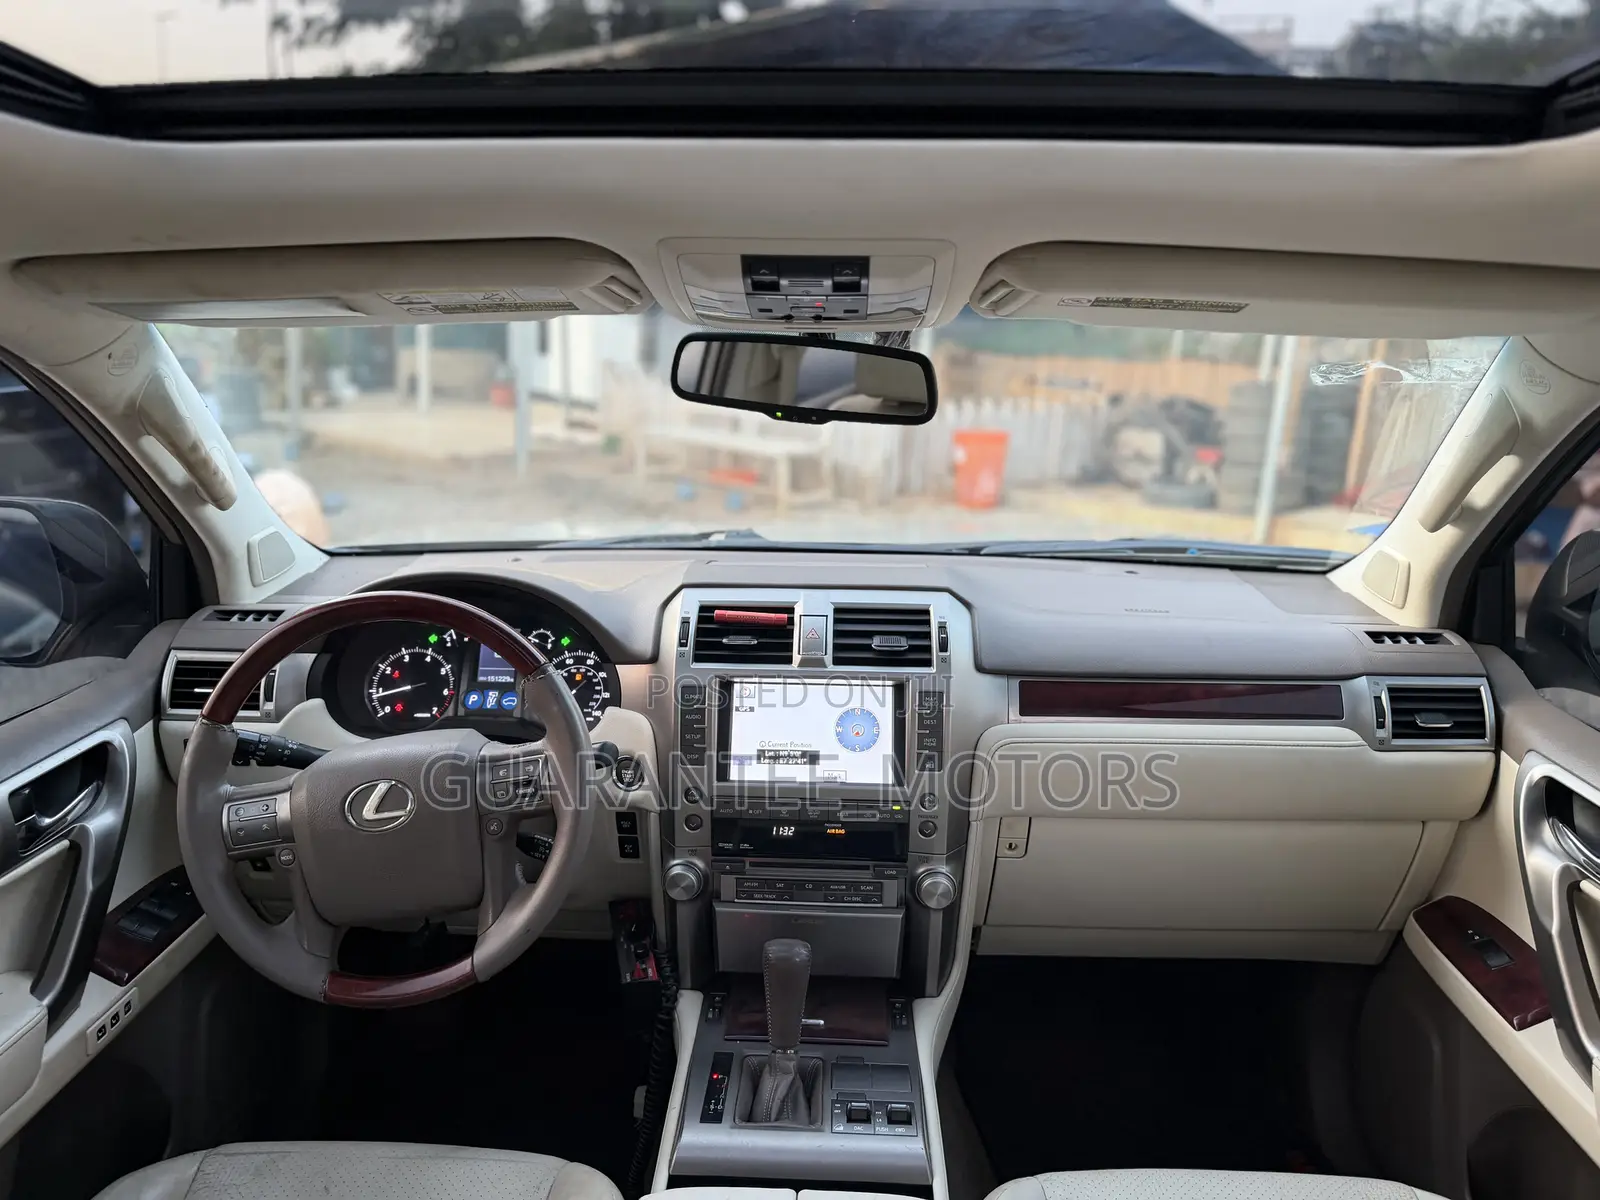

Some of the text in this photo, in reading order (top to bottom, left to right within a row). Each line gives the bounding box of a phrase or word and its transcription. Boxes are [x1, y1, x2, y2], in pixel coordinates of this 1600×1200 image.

[384, 705, 391, 713] 0
[767, 740, 788, 748] Current
[772, 826, 795, 836] 11:32
